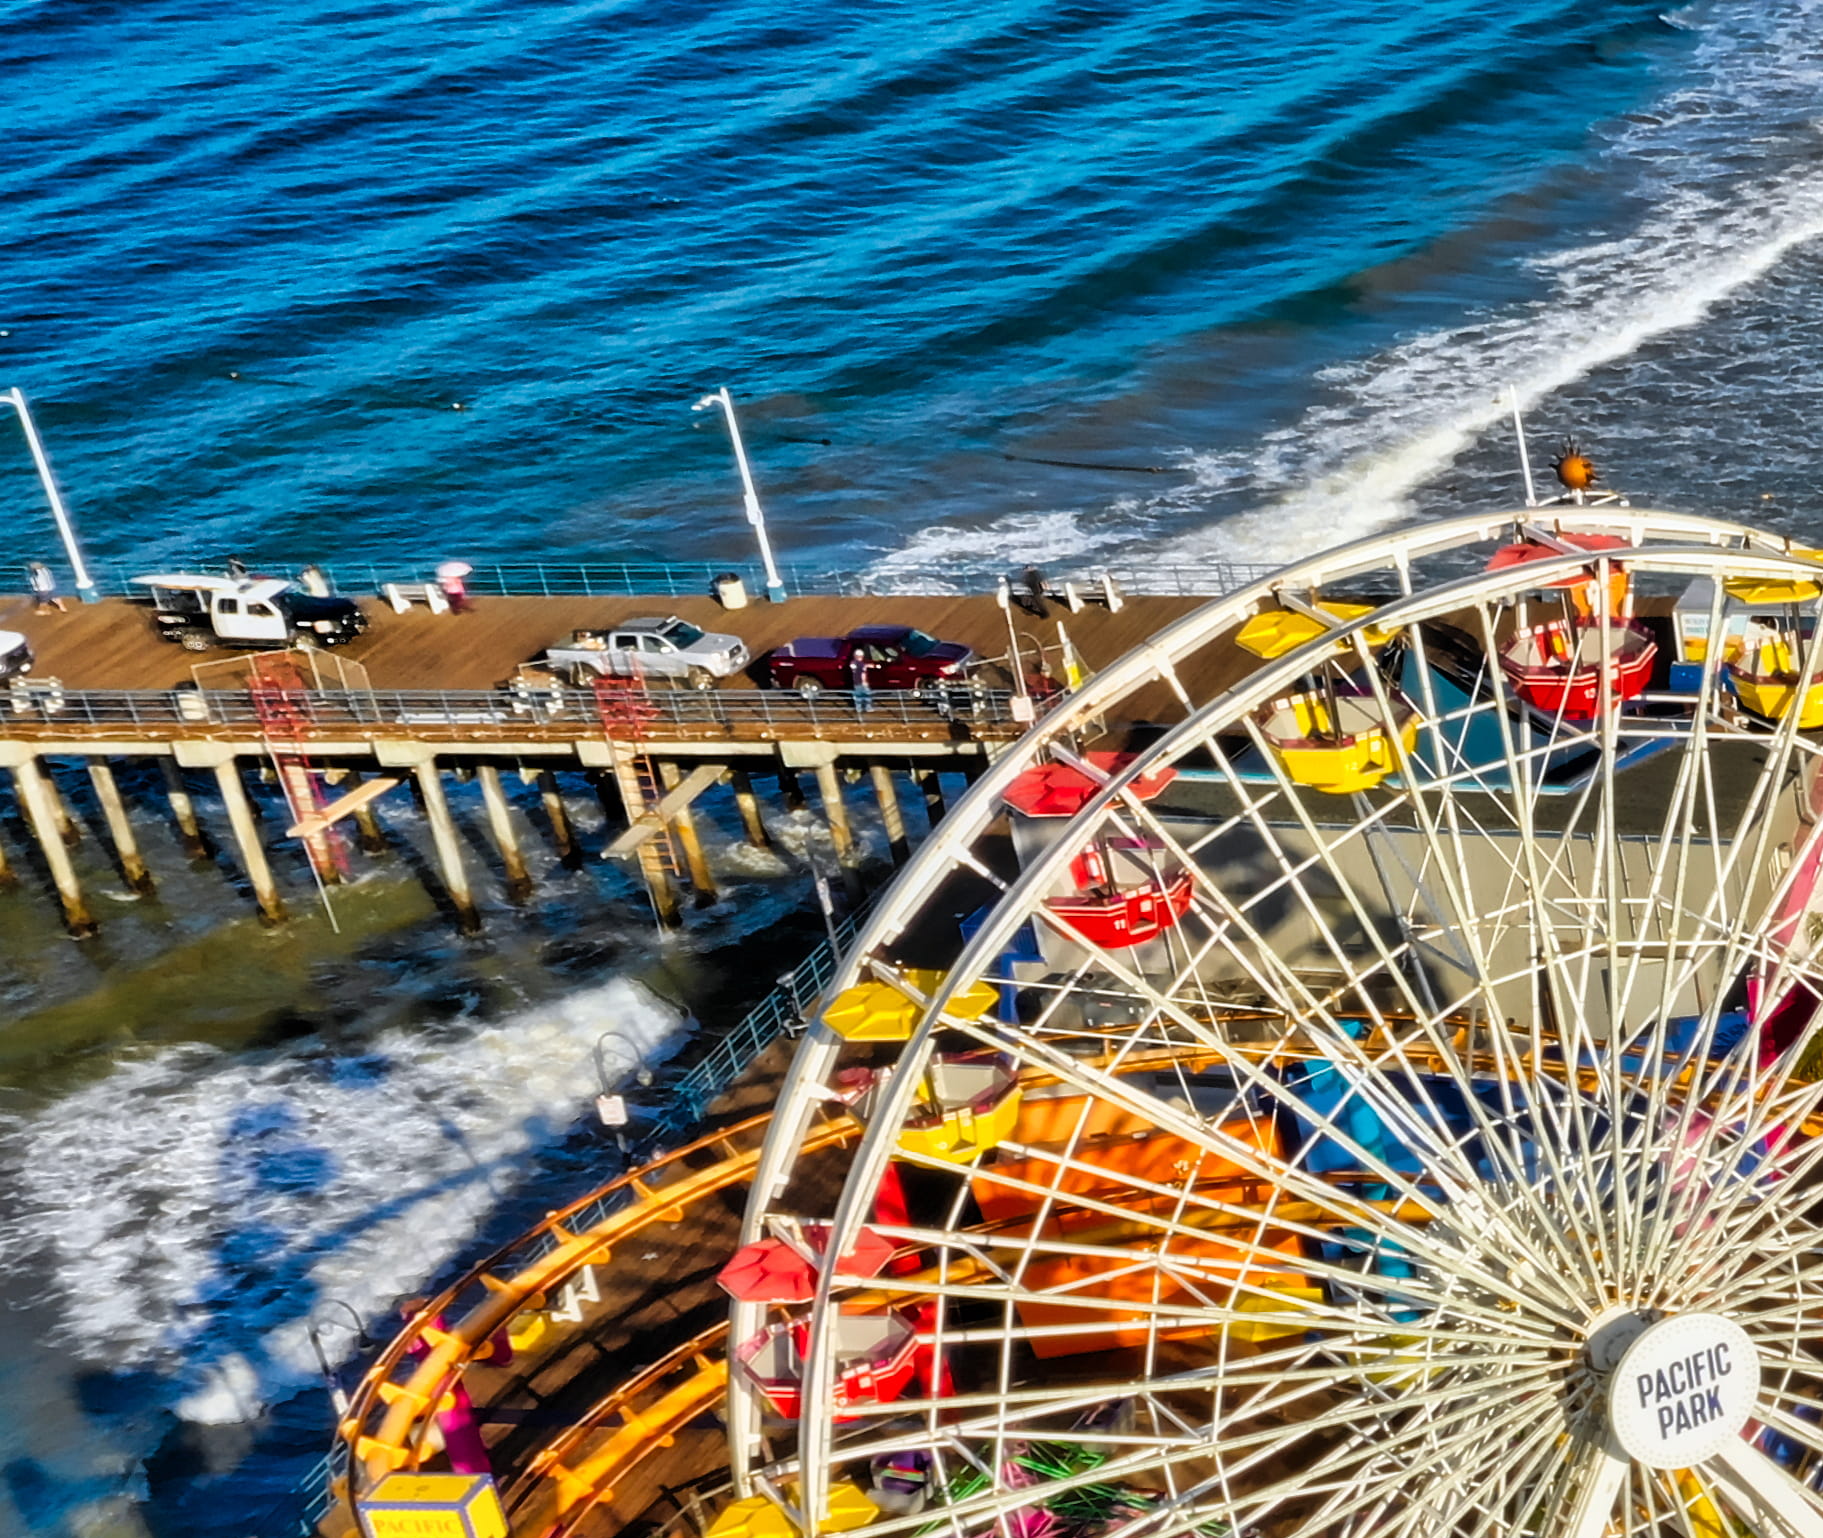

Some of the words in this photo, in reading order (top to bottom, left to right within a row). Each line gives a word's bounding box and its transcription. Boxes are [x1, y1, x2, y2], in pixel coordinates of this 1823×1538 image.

[1113, 919, 1126, 931] 11
[1636, 1342, 1733, 1409] PACIFIC
[1658, 1385, 1725, 1440] PARK
[374, 1519, 458, 1534] PACIFIC
